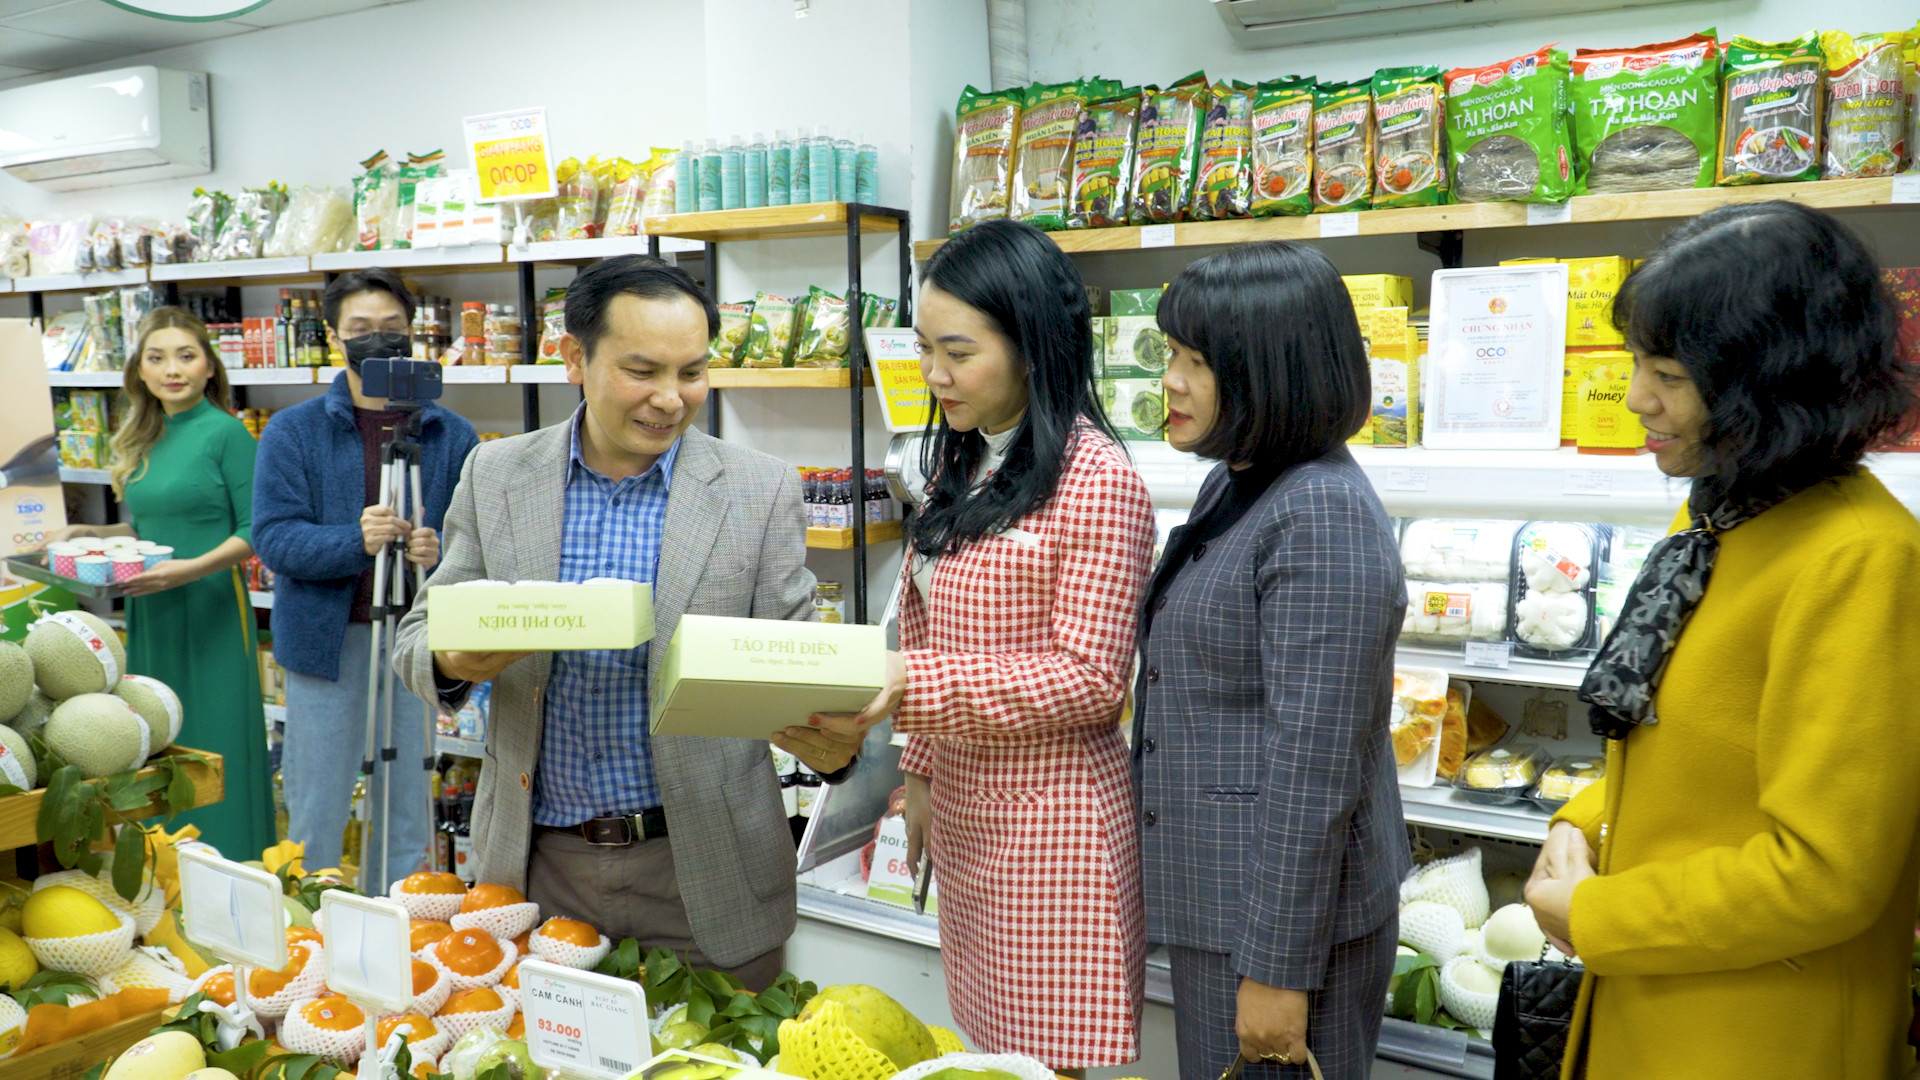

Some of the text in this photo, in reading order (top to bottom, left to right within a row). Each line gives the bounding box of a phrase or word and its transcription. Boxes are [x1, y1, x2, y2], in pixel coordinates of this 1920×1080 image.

[1630, 88, 1698, 113] HOAN
[1454, 96, 1534, 131] TÀI HOAN
[489, 163, 537, 186] OCOP
[1476, 346, 1514, 358] OCO
[1587, 388, 1626, 404] Honey
[17, 503, 44, 514] ISO
[880, 834, 900, 847] ROI
[531, 987, 583, 1009] CAM CANH
[538, 1018, 582, 1039] 93.000
